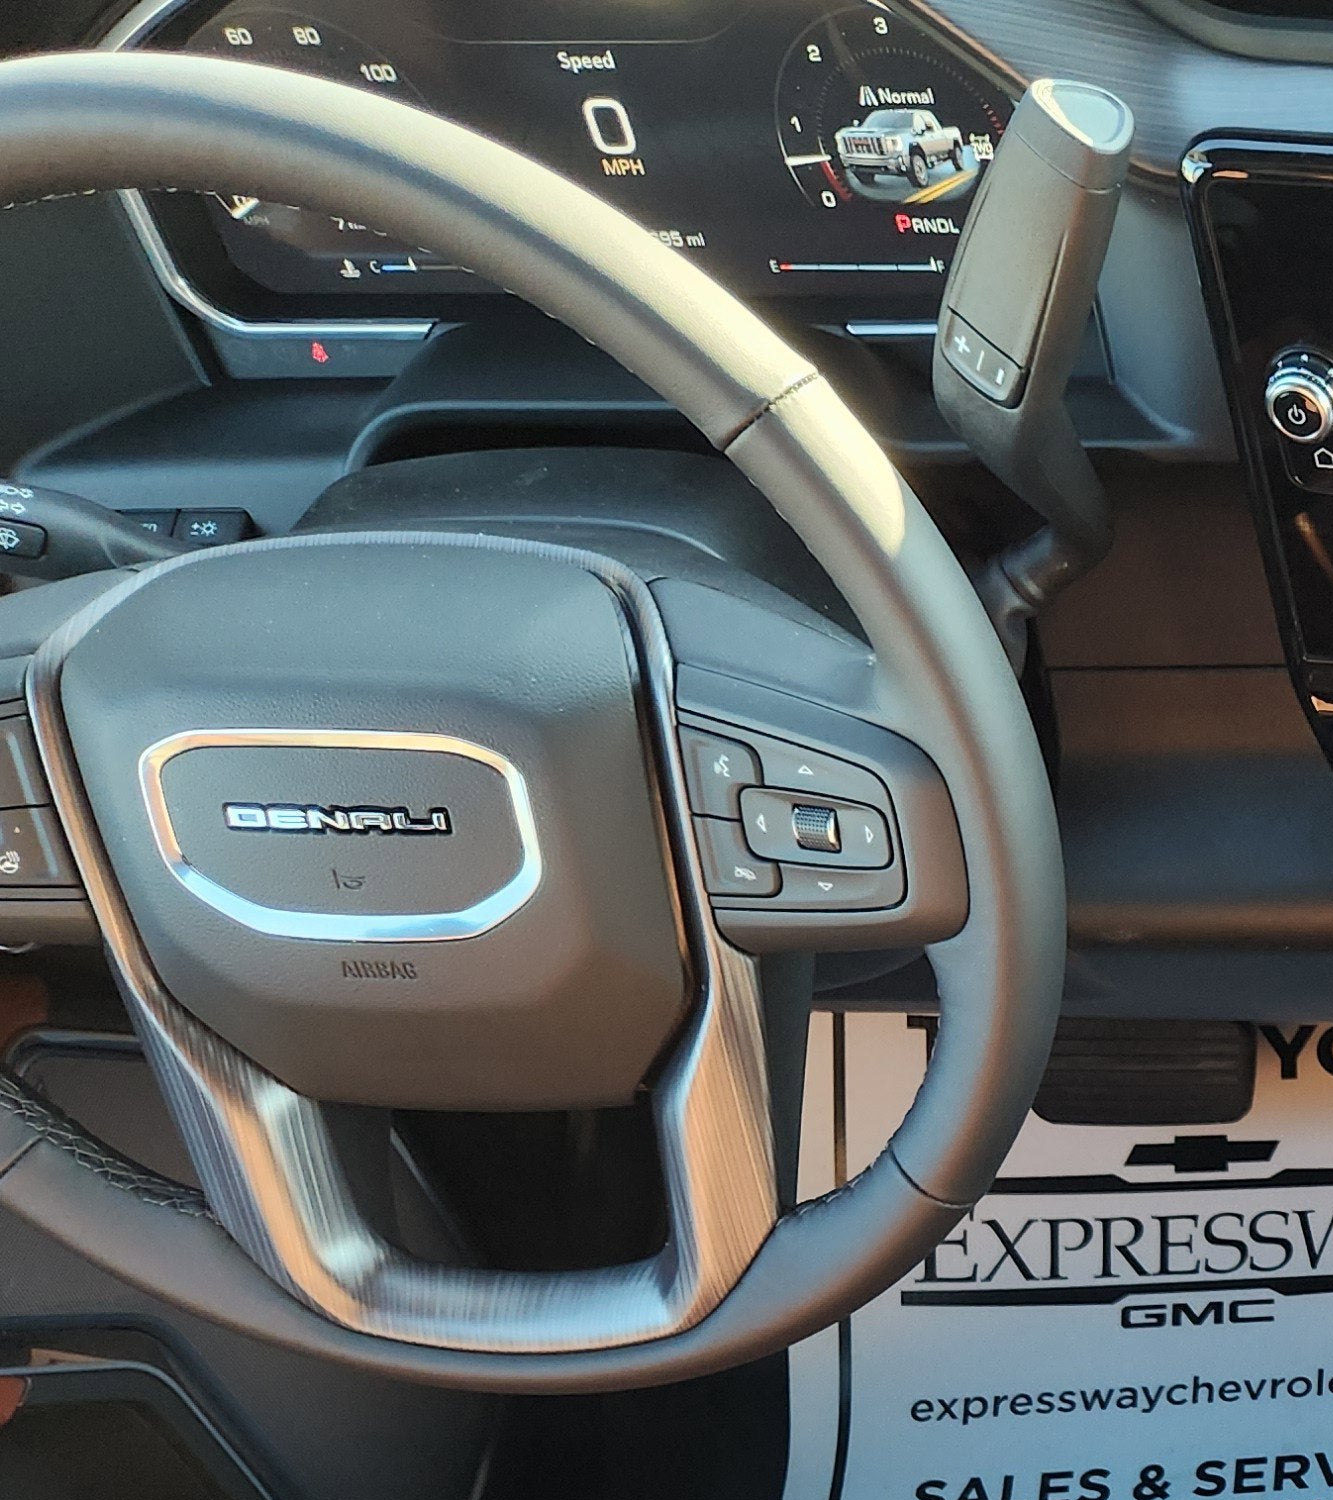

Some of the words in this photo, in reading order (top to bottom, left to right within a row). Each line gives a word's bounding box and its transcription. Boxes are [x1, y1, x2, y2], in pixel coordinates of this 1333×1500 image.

[873, 16, 889, 35] 3
[224, 26, 254, 46] 60
[292, 25, 322, 46] 80
[557, 50, 617, 73] Speed
[806, 44, 823, 63] 2
[360, 62, 398, 83] 100
[877, 87, 936, 106] Normal
[582, 97, 637, 155] 0
[790, 116, 802, 133] 1
[601, 158, 646, 176] MPH
[820, 190, 838, 208] 0
[369, 260, 382, 274] C
[768, 259, 781, 274] E
[223, 803, 452, 835] DENALI
[342, 960, 418, 979] AIRBAG
[1120, 1298, 1275, 1328] GMC
[1132, 1463, 1171, 1500] &
